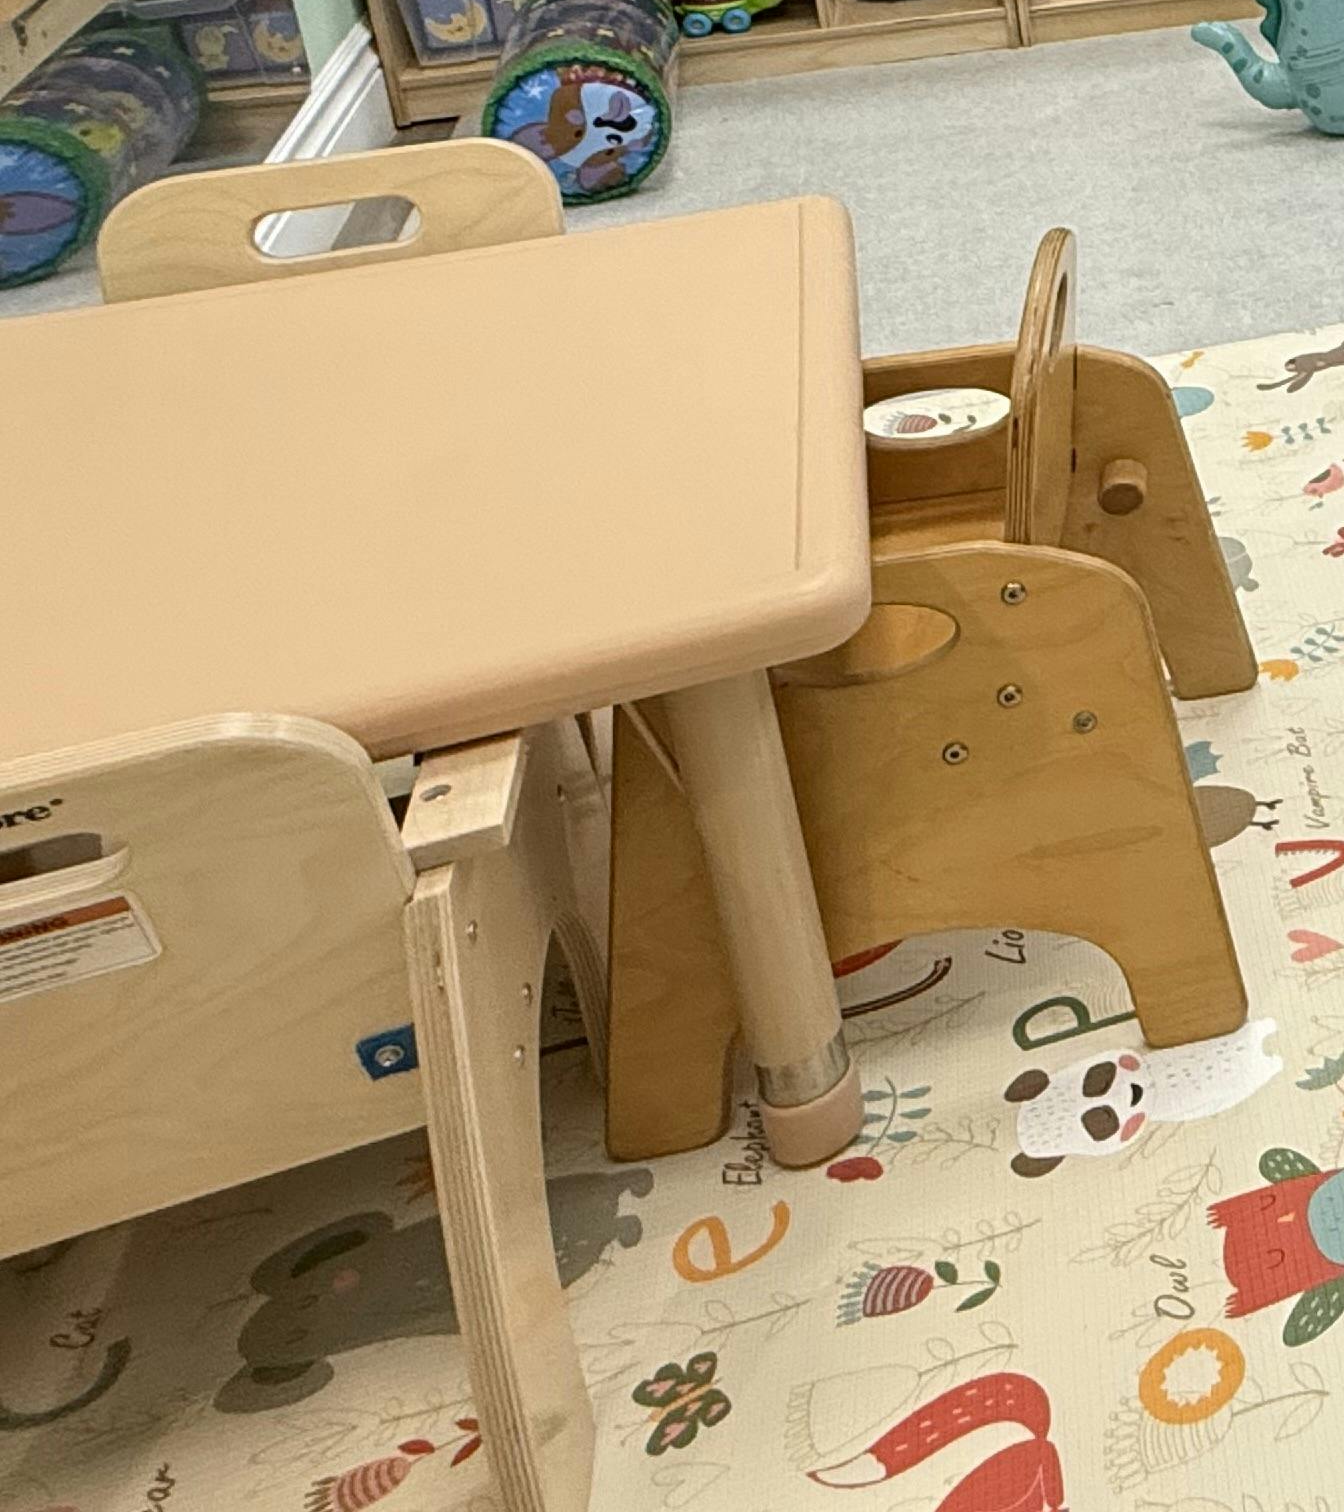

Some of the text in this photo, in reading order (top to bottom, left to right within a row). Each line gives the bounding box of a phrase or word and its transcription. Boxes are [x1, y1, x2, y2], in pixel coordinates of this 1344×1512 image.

[1286, 726, 1331, 829] Vampire Bat
[984, 929, 1027, 965] Lio
[1150, 1253, 1196, 1321] Owl
[49, 1306, 102, 1350] Cat
